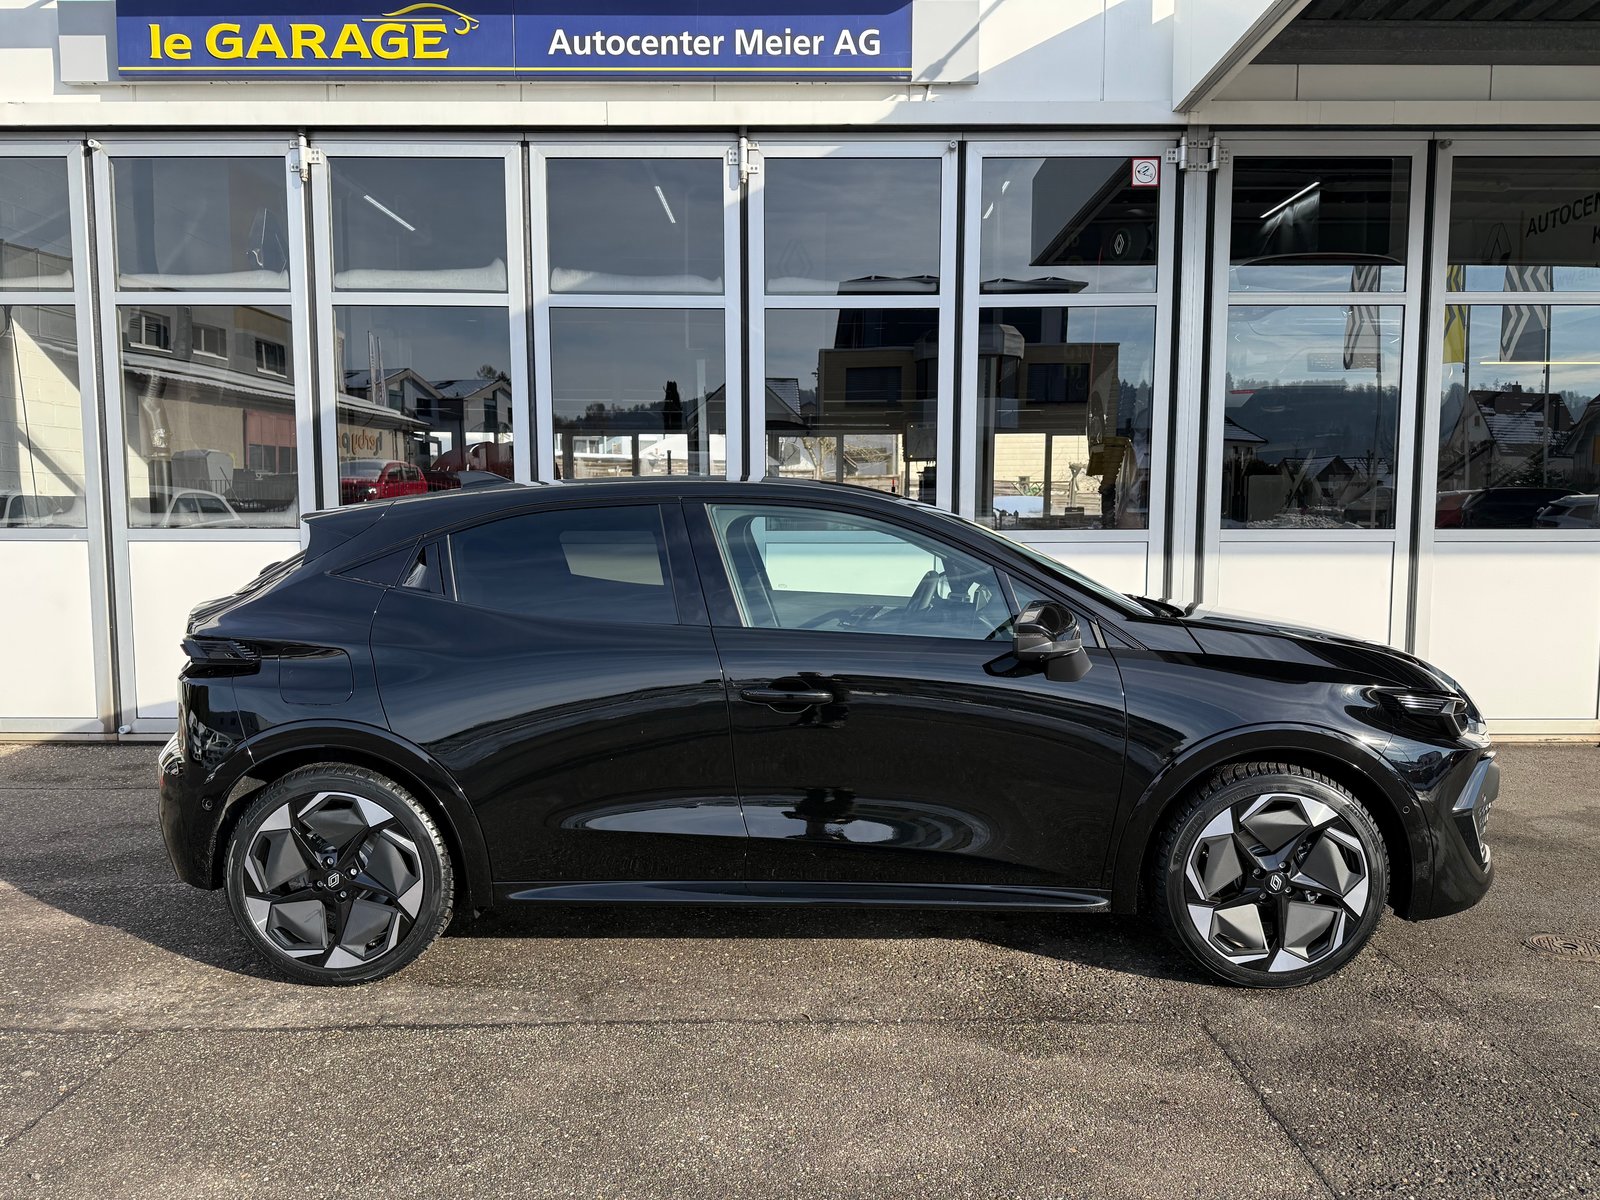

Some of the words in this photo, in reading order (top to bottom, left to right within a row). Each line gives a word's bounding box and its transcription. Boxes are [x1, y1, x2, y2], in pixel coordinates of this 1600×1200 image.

[148, 23, 192, 60] le
[205, 23, 450, 60] GARAGE
[548, 28, 725, 56] Autocenter
[735, 28, 825, 56] Meier
[834, 28, 881, 56] AG
